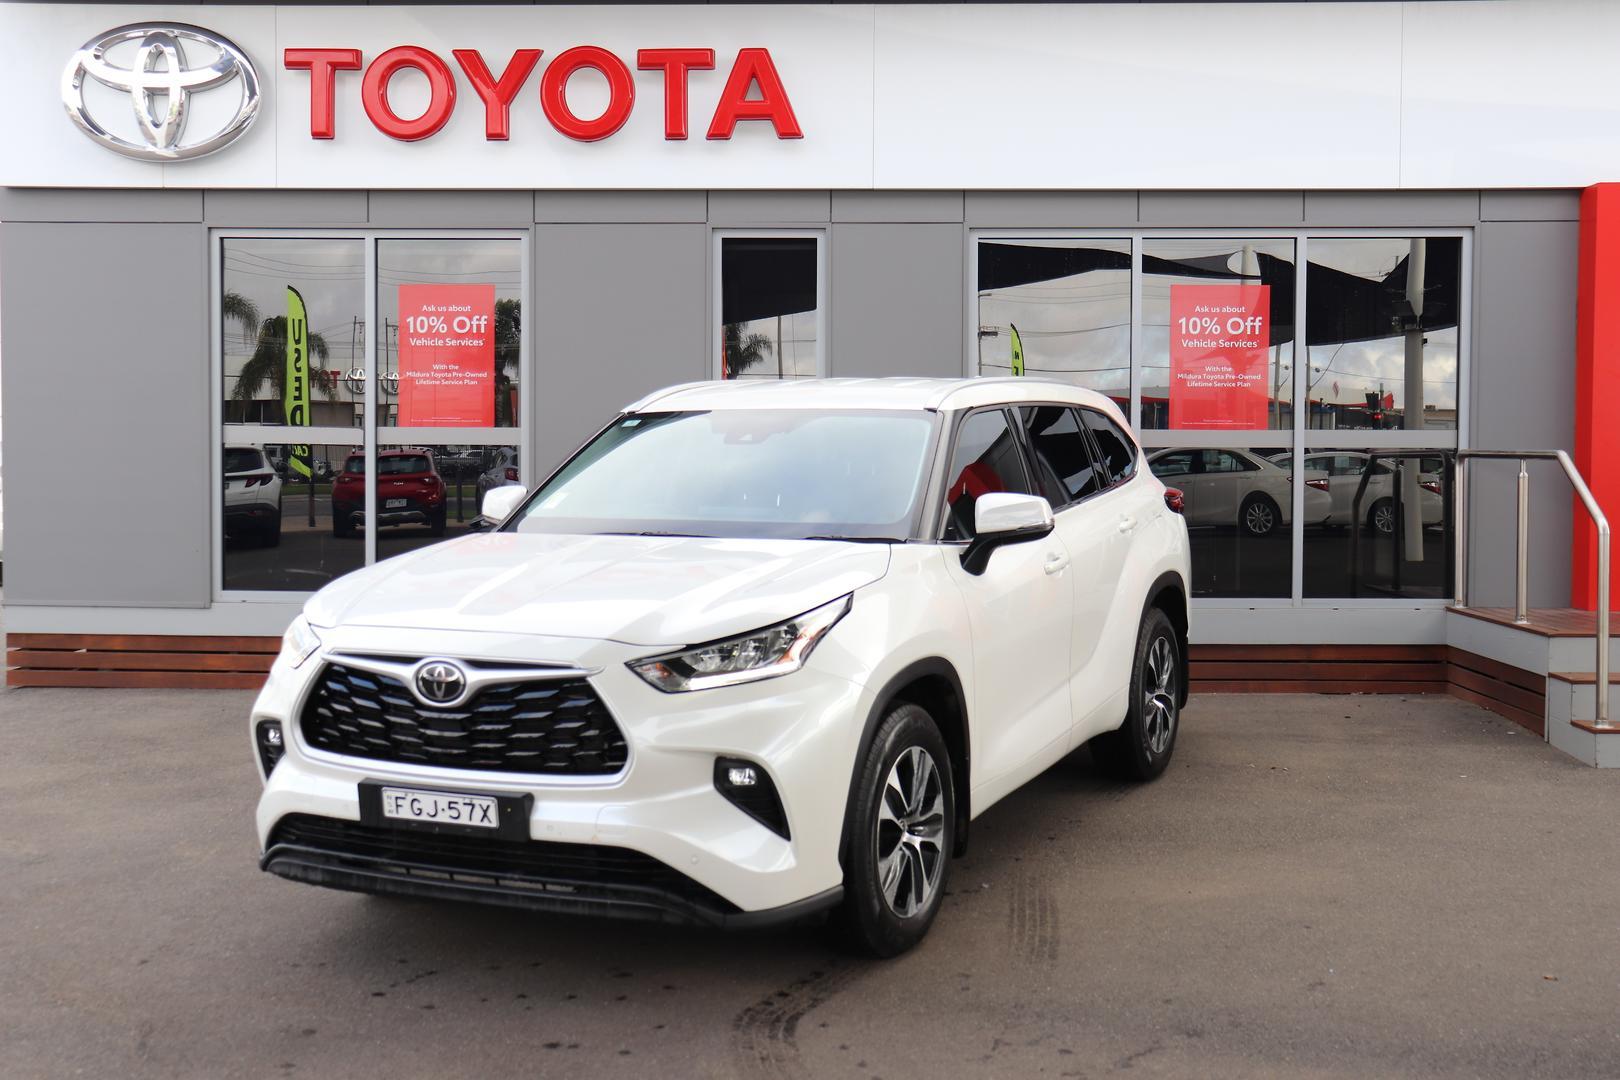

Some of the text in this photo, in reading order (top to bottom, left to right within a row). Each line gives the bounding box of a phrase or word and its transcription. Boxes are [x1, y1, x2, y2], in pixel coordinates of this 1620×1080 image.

[284, 45, 804, 143] TOYOTA
[448, 304, 471, 312] about
[1194, 305, 1209, 313] Ask
[1221, 305, 1246, 313] about
[406, 315, 488, 334] 10% Off
[1178, 316, 1263, 335] 10% Off
[409, 337, 444, 347] Vehicle
[1181, 339, 1217, 348] Vehicle
[430, 372, 452, 380] Toyota
[1202, 373, 1225, 381] Toyota
